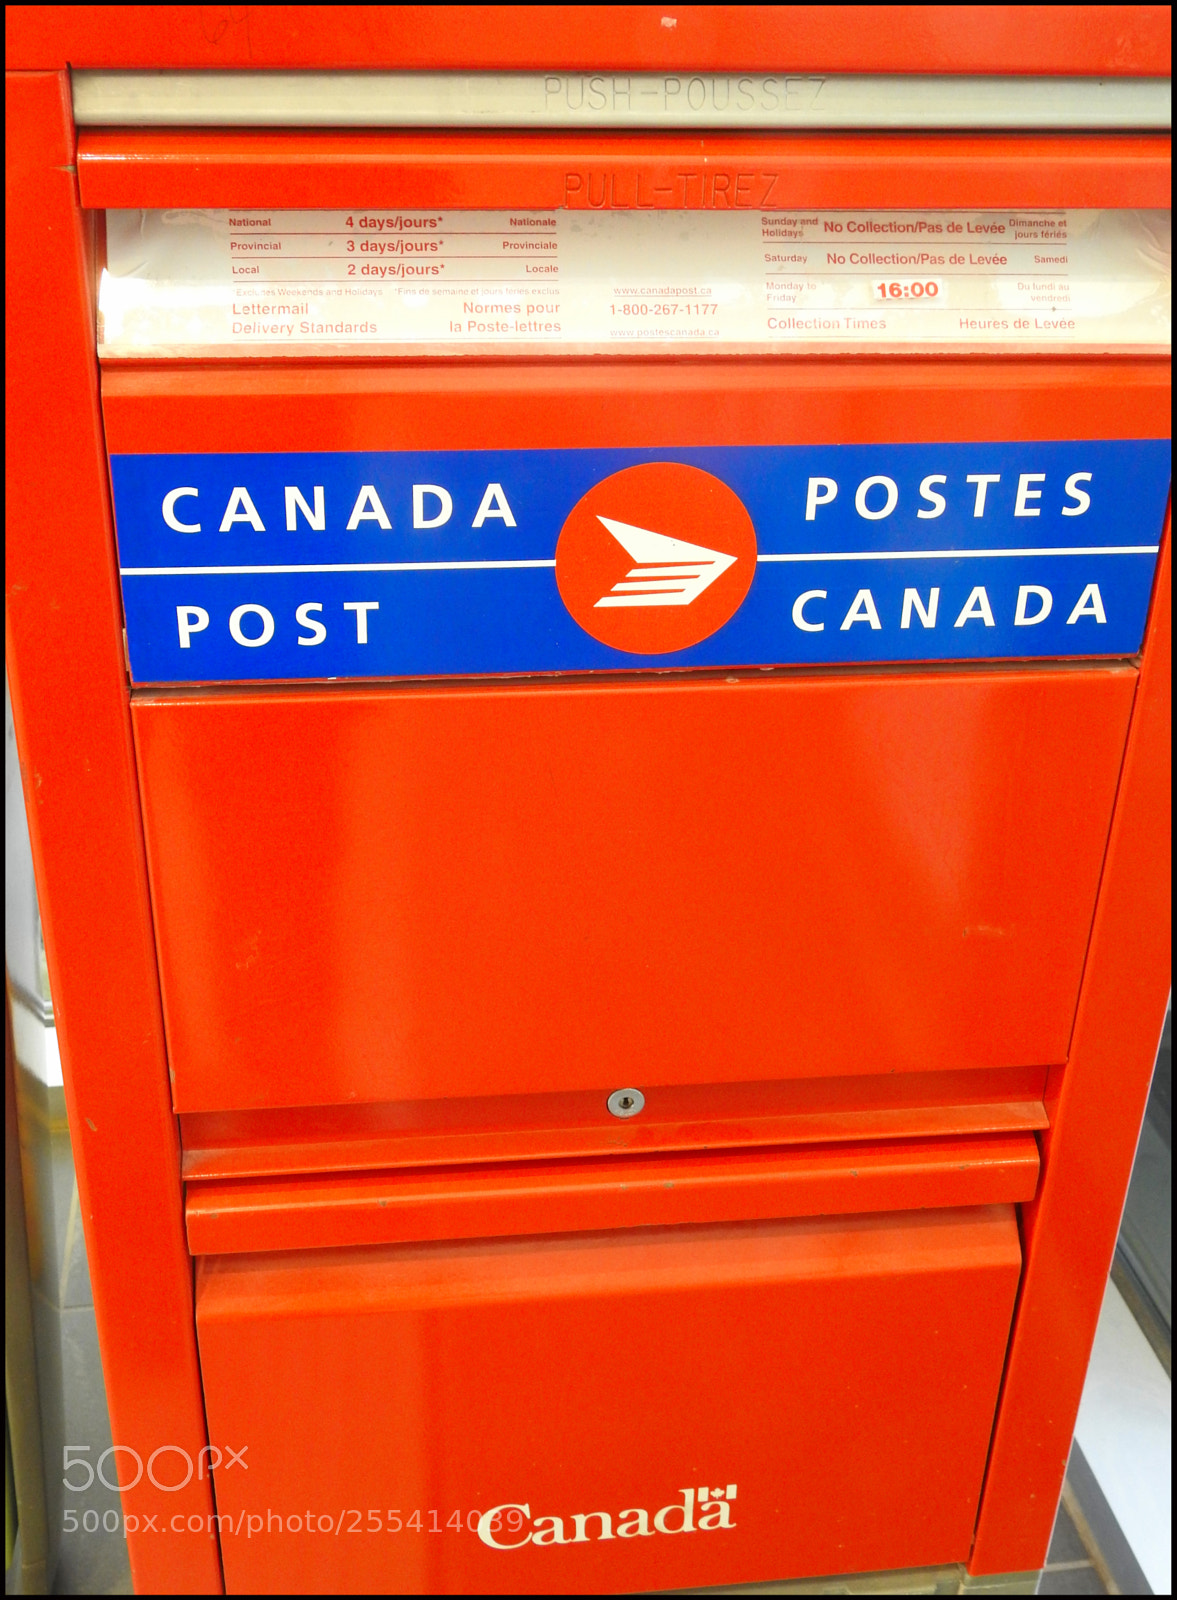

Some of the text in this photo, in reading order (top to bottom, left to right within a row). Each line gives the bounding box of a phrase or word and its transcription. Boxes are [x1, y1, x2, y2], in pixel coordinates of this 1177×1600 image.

[545, 76, 826, 111] PUSH-POUSSEZ
[564, 172, 779, 208] PULL-TIREZ
[229, 218, 271, 227] National
[345, 216, 354, 228] 4
[510, 217, 557, 227] Nationale
[761, 217, 819, 227] Sunday and
[824, 221, 1006, 234] No Collection/Pas de Levée
[1009, 219, 1067, 228] Dimanche et
[762, 229, 804, 239] Holidays
[1015, 230, 1068, 240] jours fériés
[230, 241, 282, 251] Provincial
[346, 240, 355, 252] 3
[502, 241, 558, 250] Provinciale
[764, 253, 808, 264] Saturday
[827, 253, 1008, 265] No Collection/Pas de Levée
[1034, 255, 1069, 264] Samedi
[232, 265, 260, 274] Local
[347, 264, 356, 276] 2
[525, 264, 559, 273] Locale
[419, 287, 430, 295] de
[432, 287, 469, 296] semaine
[471, 287, 480, 296] et
[532, 287, 560, 296] exclus
[613, 286, 713, 297] www.canadapost.ca
[766, 281, 817, 291] Monday to
[877, 281, 939, 299] 16:00
[1017, 282, 1070, 291] Du lundi au
[277, 287, 324, 296] Weekends
[326, 287, 343, 296] and
[344, 287, 383, 297] Holidays
[766, 293, 797, 303] Friday
[1031, 294, 1071, 303] vendredi
[232, 302, 309, 315] Lettermail
[463, 302, 561, 316] Normes pour
[610, 303, 718, 316] 1-800-267-1177
[232, 321, 378, 336] Delivery Standards
[450, 320, 562, 333] la Poste-lettres
[767, 317, 887, 330] Collection Times
[959, 317, 1076, 330] Heures de Levée
[610, 328, 720, 338] www.postescanada.ca
[805, 471, 1093, 521] POSTES
[162, 483, 518, 534] CANADA
[791, 583, 1108, 632] CANADA
[176, 601, 380, 649] POST
[477, 1485, 737, 1550] Canada
